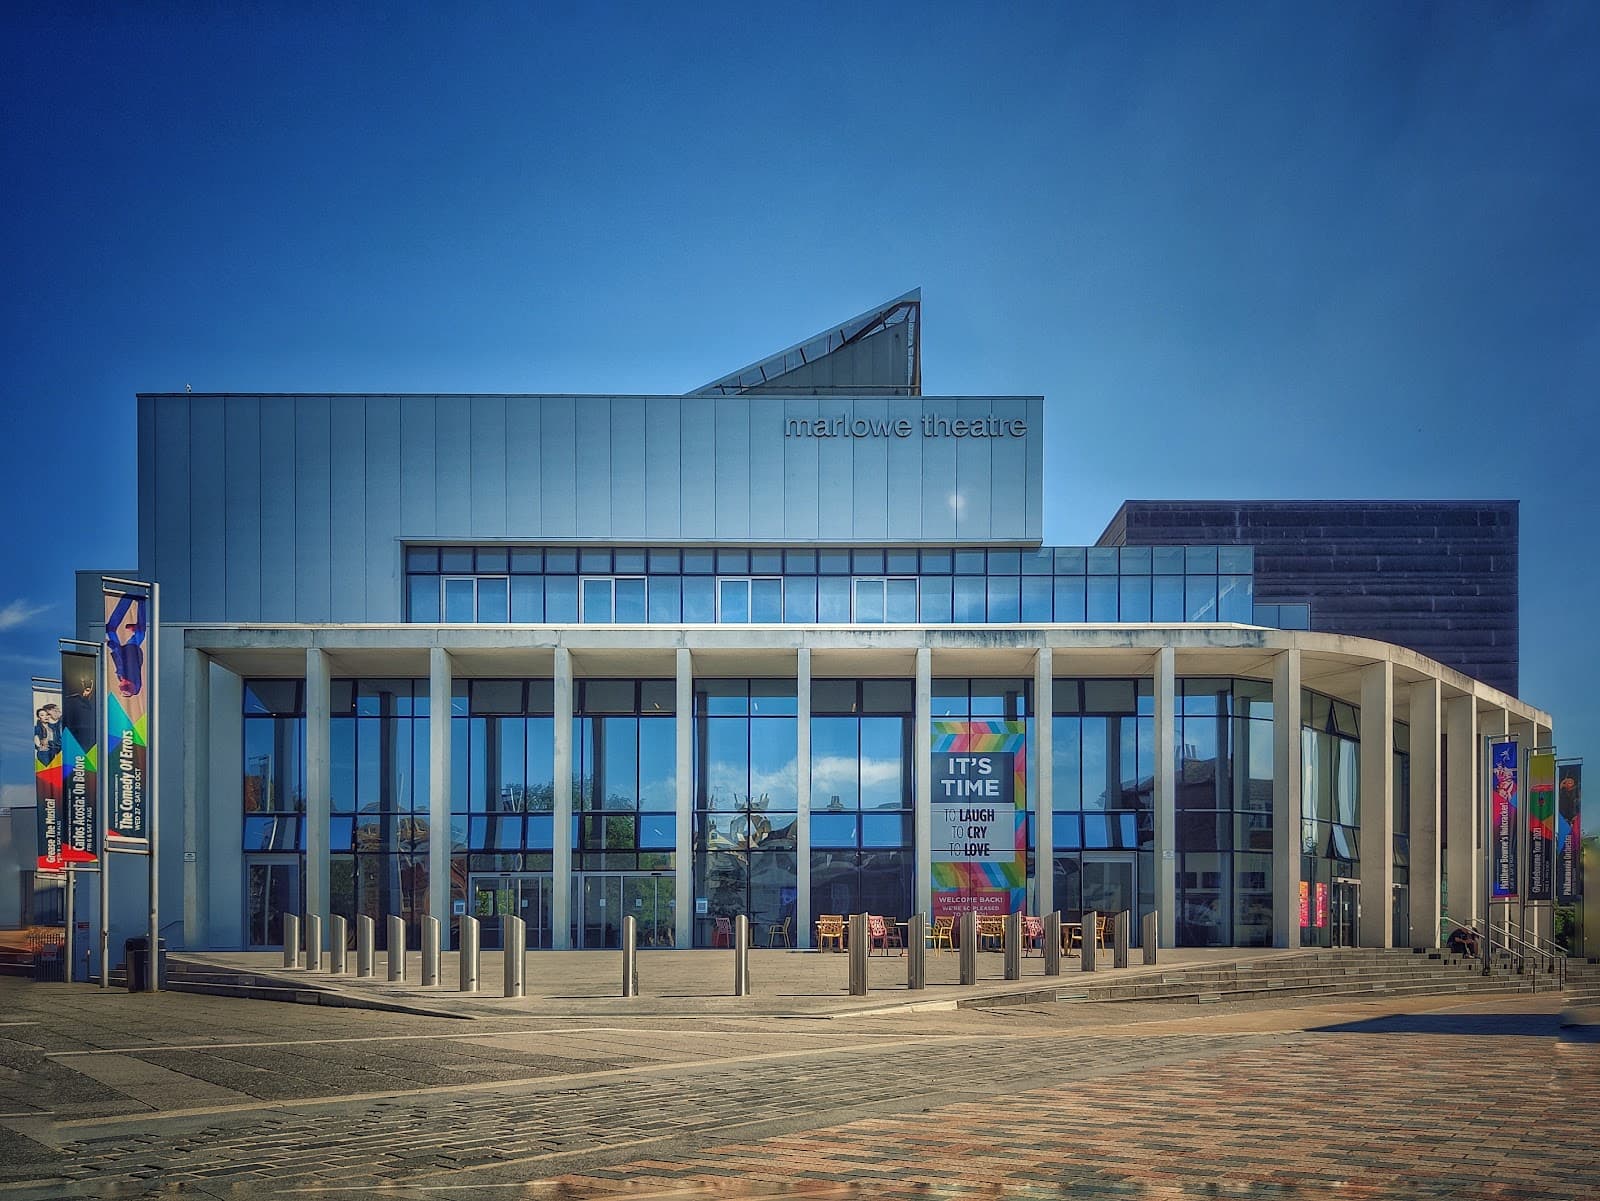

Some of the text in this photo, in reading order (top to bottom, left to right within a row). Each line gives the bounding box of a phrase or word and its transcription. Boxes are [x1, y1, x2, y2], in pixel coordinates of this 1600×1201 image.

[785, 411, 1027, 437] marlowe theatre
[949, 757, 992, 775] IT’S
[119, 729, 135, 830] The Comedy Of Errors
[133, 767, 141, 782] OCT
[134, 782, 141, 790] 30
[940, 779, 1000, 796] TIME
[72, 755, 85, 851] Carlos Acosta: On Before
[134, 807, 141, 815] 27
[944, 808, 995, 822] TO LAUGH
[44, 798, 56, 864] Grease The Musical
[951, 825, 988, 839] TO CRY
[949, 842, 991, 857] TO LOVE
